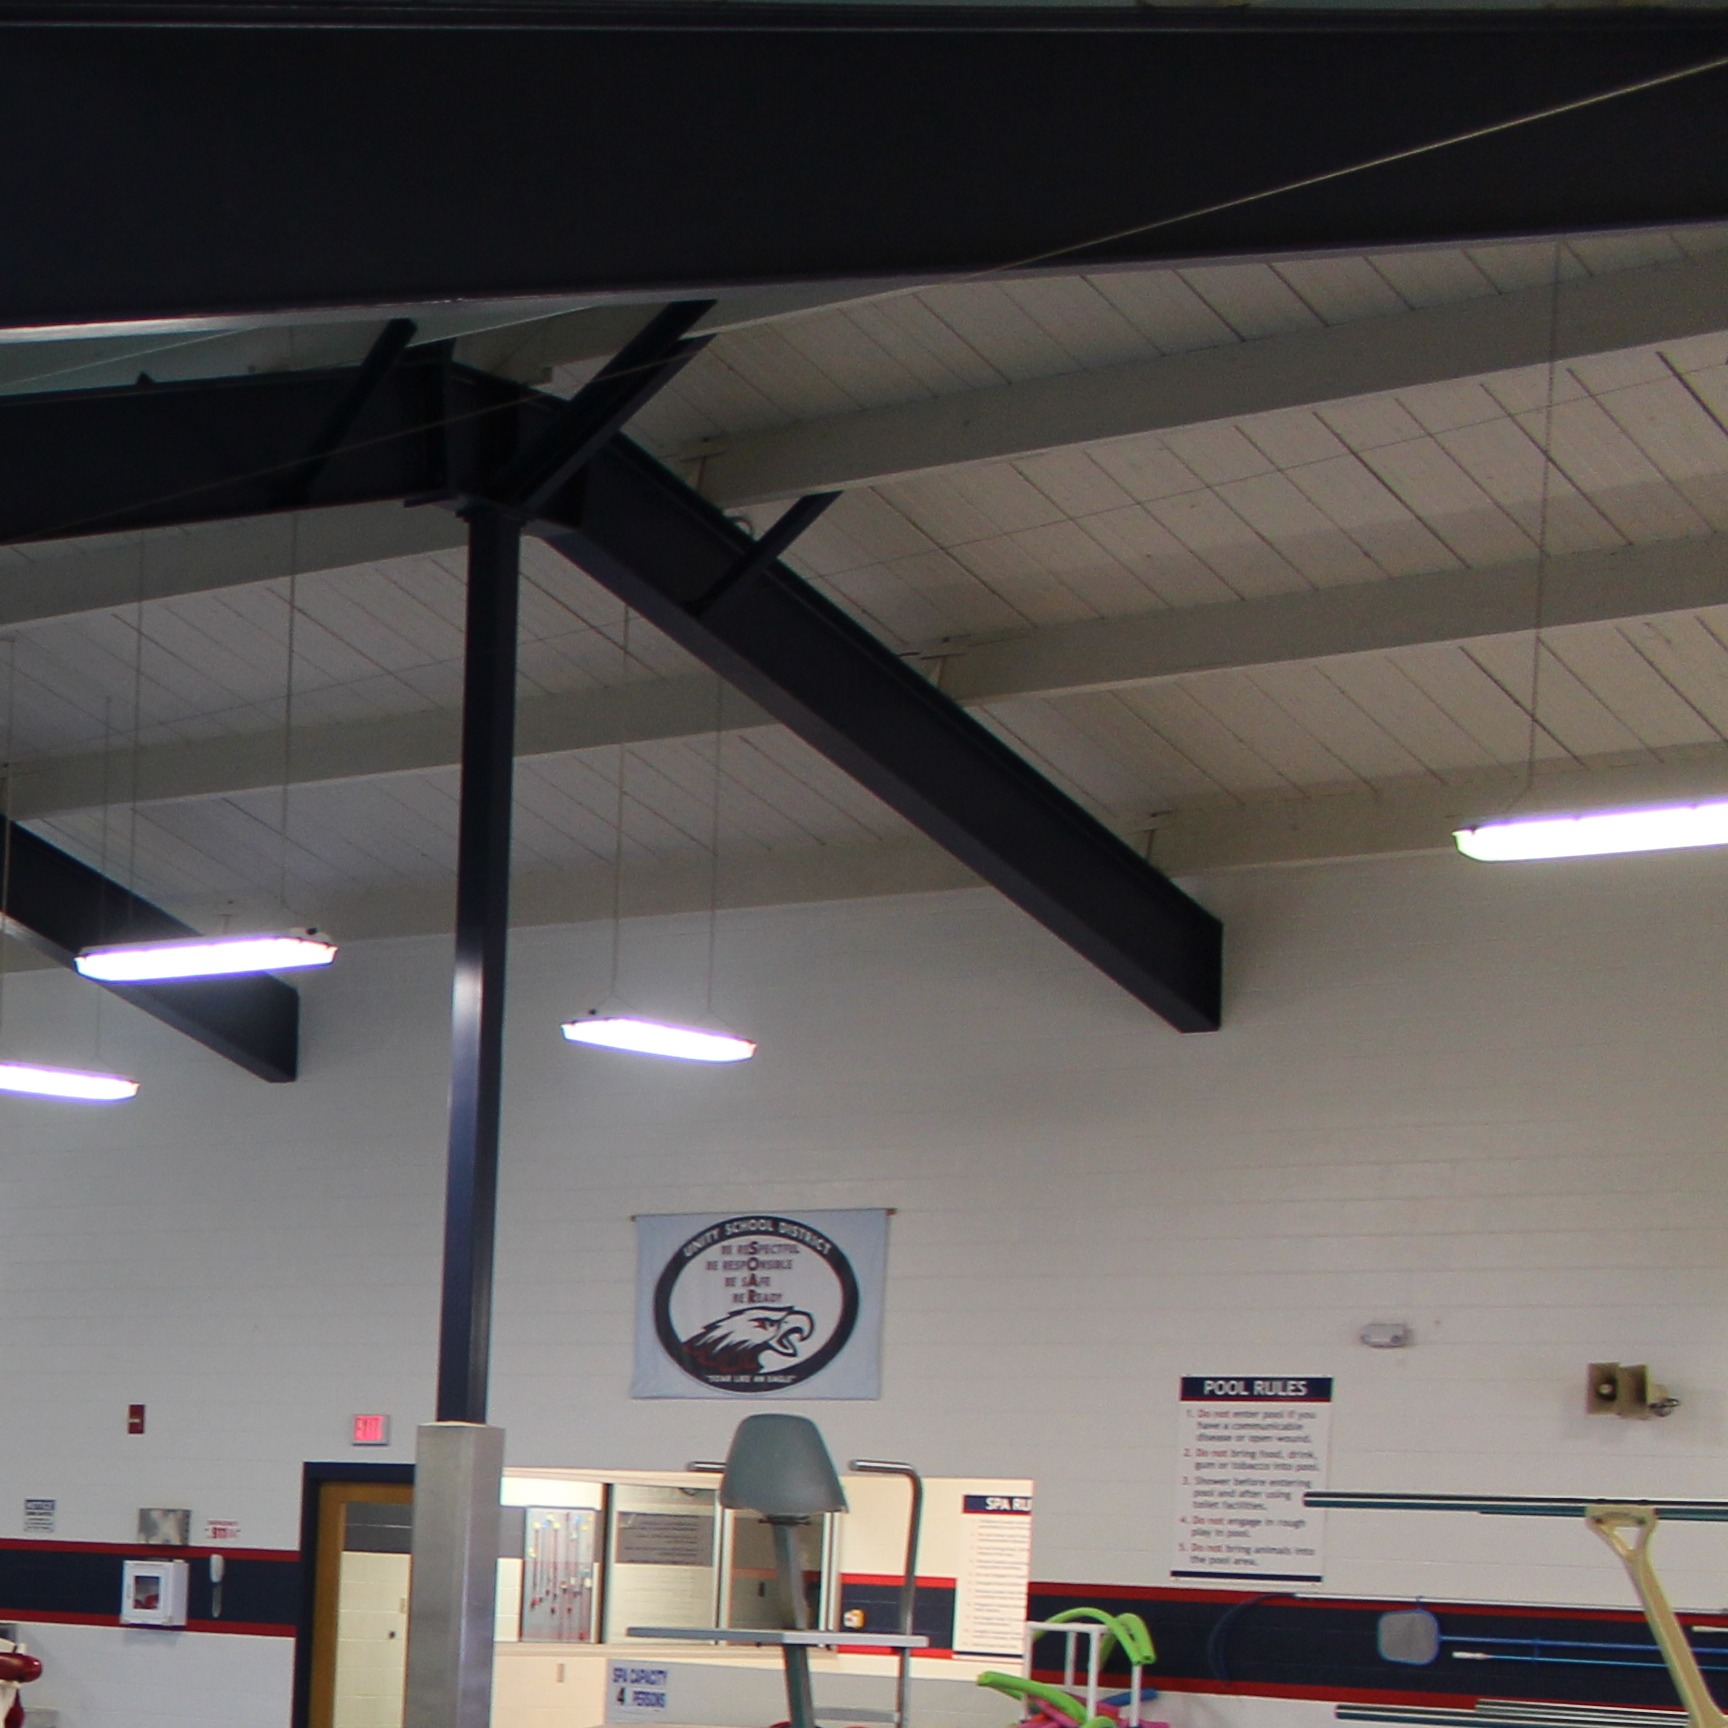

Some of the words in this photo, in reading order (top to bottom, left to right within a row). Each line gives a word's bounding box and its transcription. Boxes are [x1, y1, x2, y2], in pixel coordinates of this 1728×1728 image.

[684, 1228, 720, 1257] UNITY
[725, 1219, 774, 1235] SCHOOL
[778, 1222, 832, 1255] DISTRICT
[1204, 1381, 1249, 1396] POOL
[1253, 1381, 1308, 1396] RULES
[1215, 1410, 1229, 1418] not
[1196, 1449, 1208, 1457] Do
[986, 1497, 1010, 1511] SPA
[1206, 1544, 1222, 1552] not
[613, 1667, 627, 1683] SPA
[630, 1669, 667, 1686] CAPACITY
[617, 1687, 625, 1706] 4
[633, 1690, 666, 1708] PERSONS
